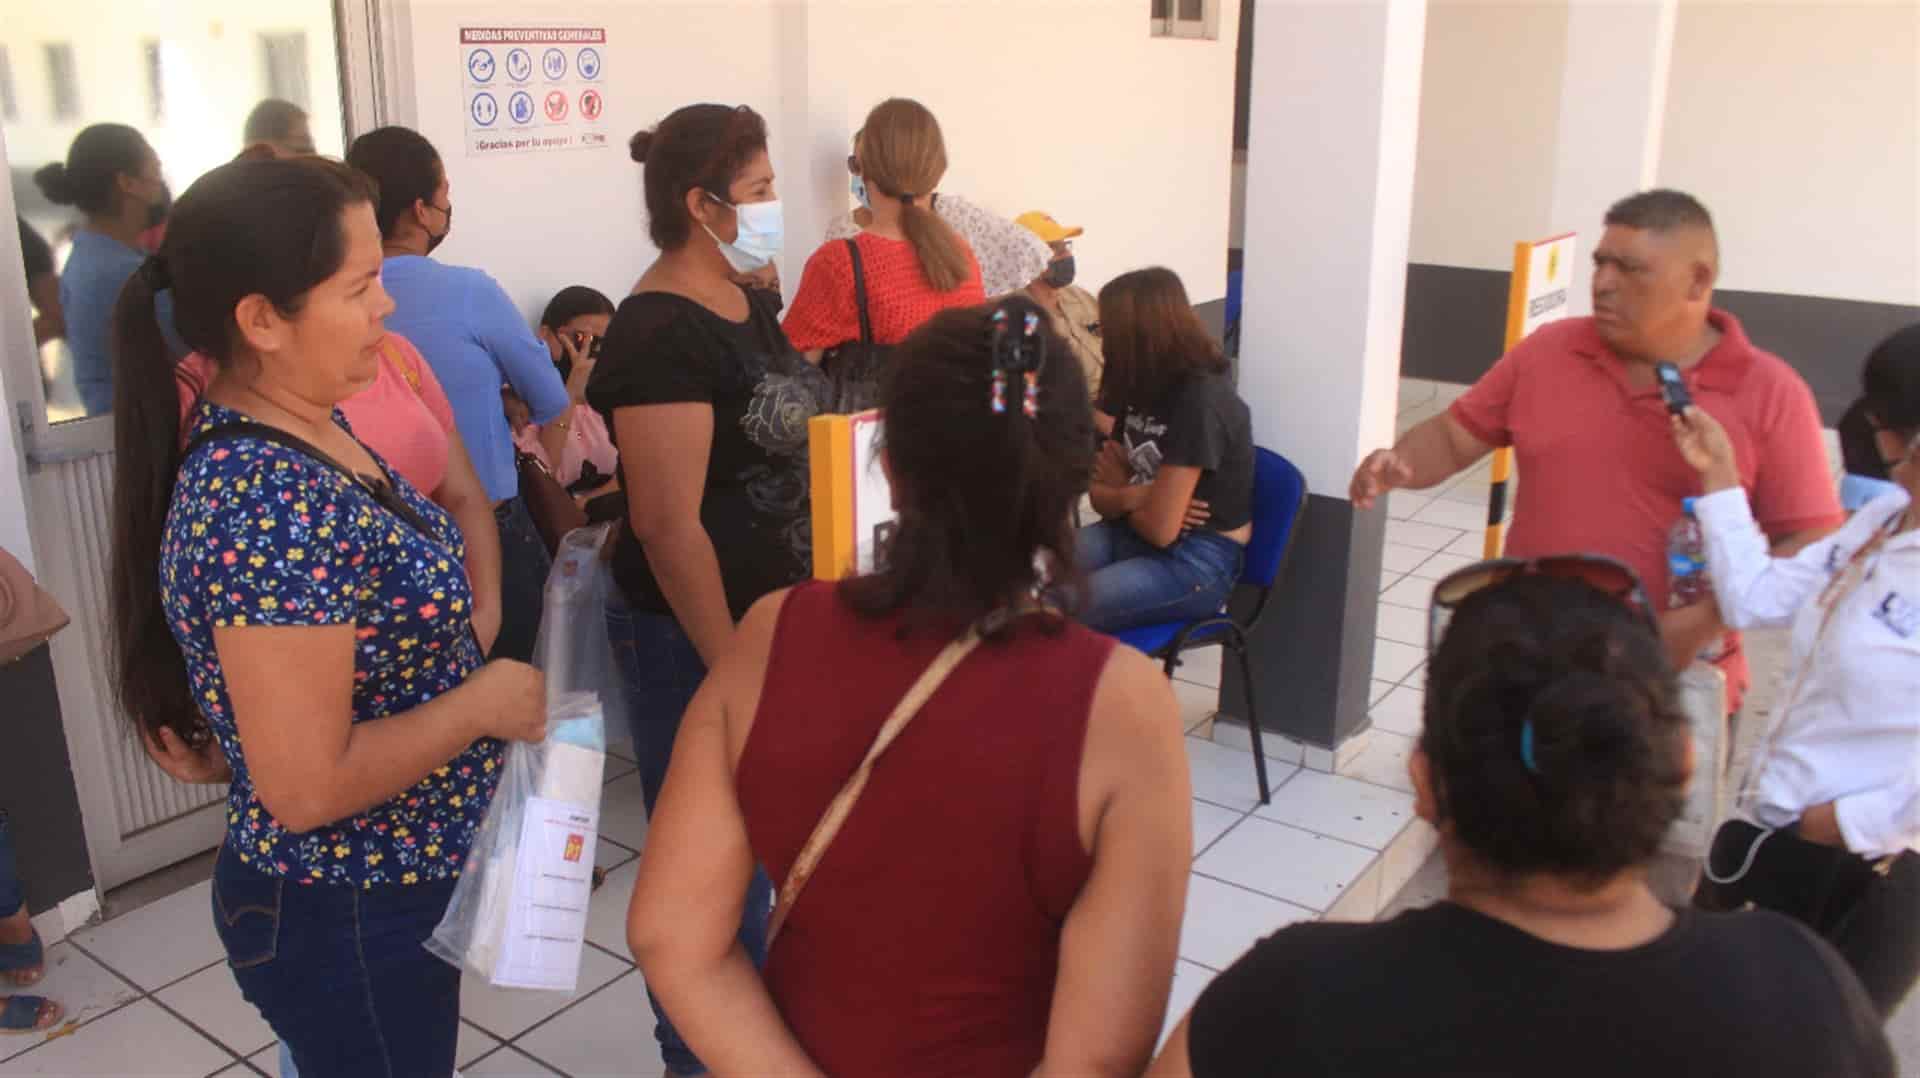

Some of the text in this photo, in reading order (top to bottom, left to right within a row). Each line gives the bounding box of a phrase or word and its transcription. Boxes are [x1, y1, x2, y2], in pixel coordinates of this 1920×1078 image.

[464, 30, 502, 41] MEDIDAS
[503, 30, 557, 41] PREVENTIVAS
[515, 139, 531, 150] por
[531, 136, 542, 147] tu
